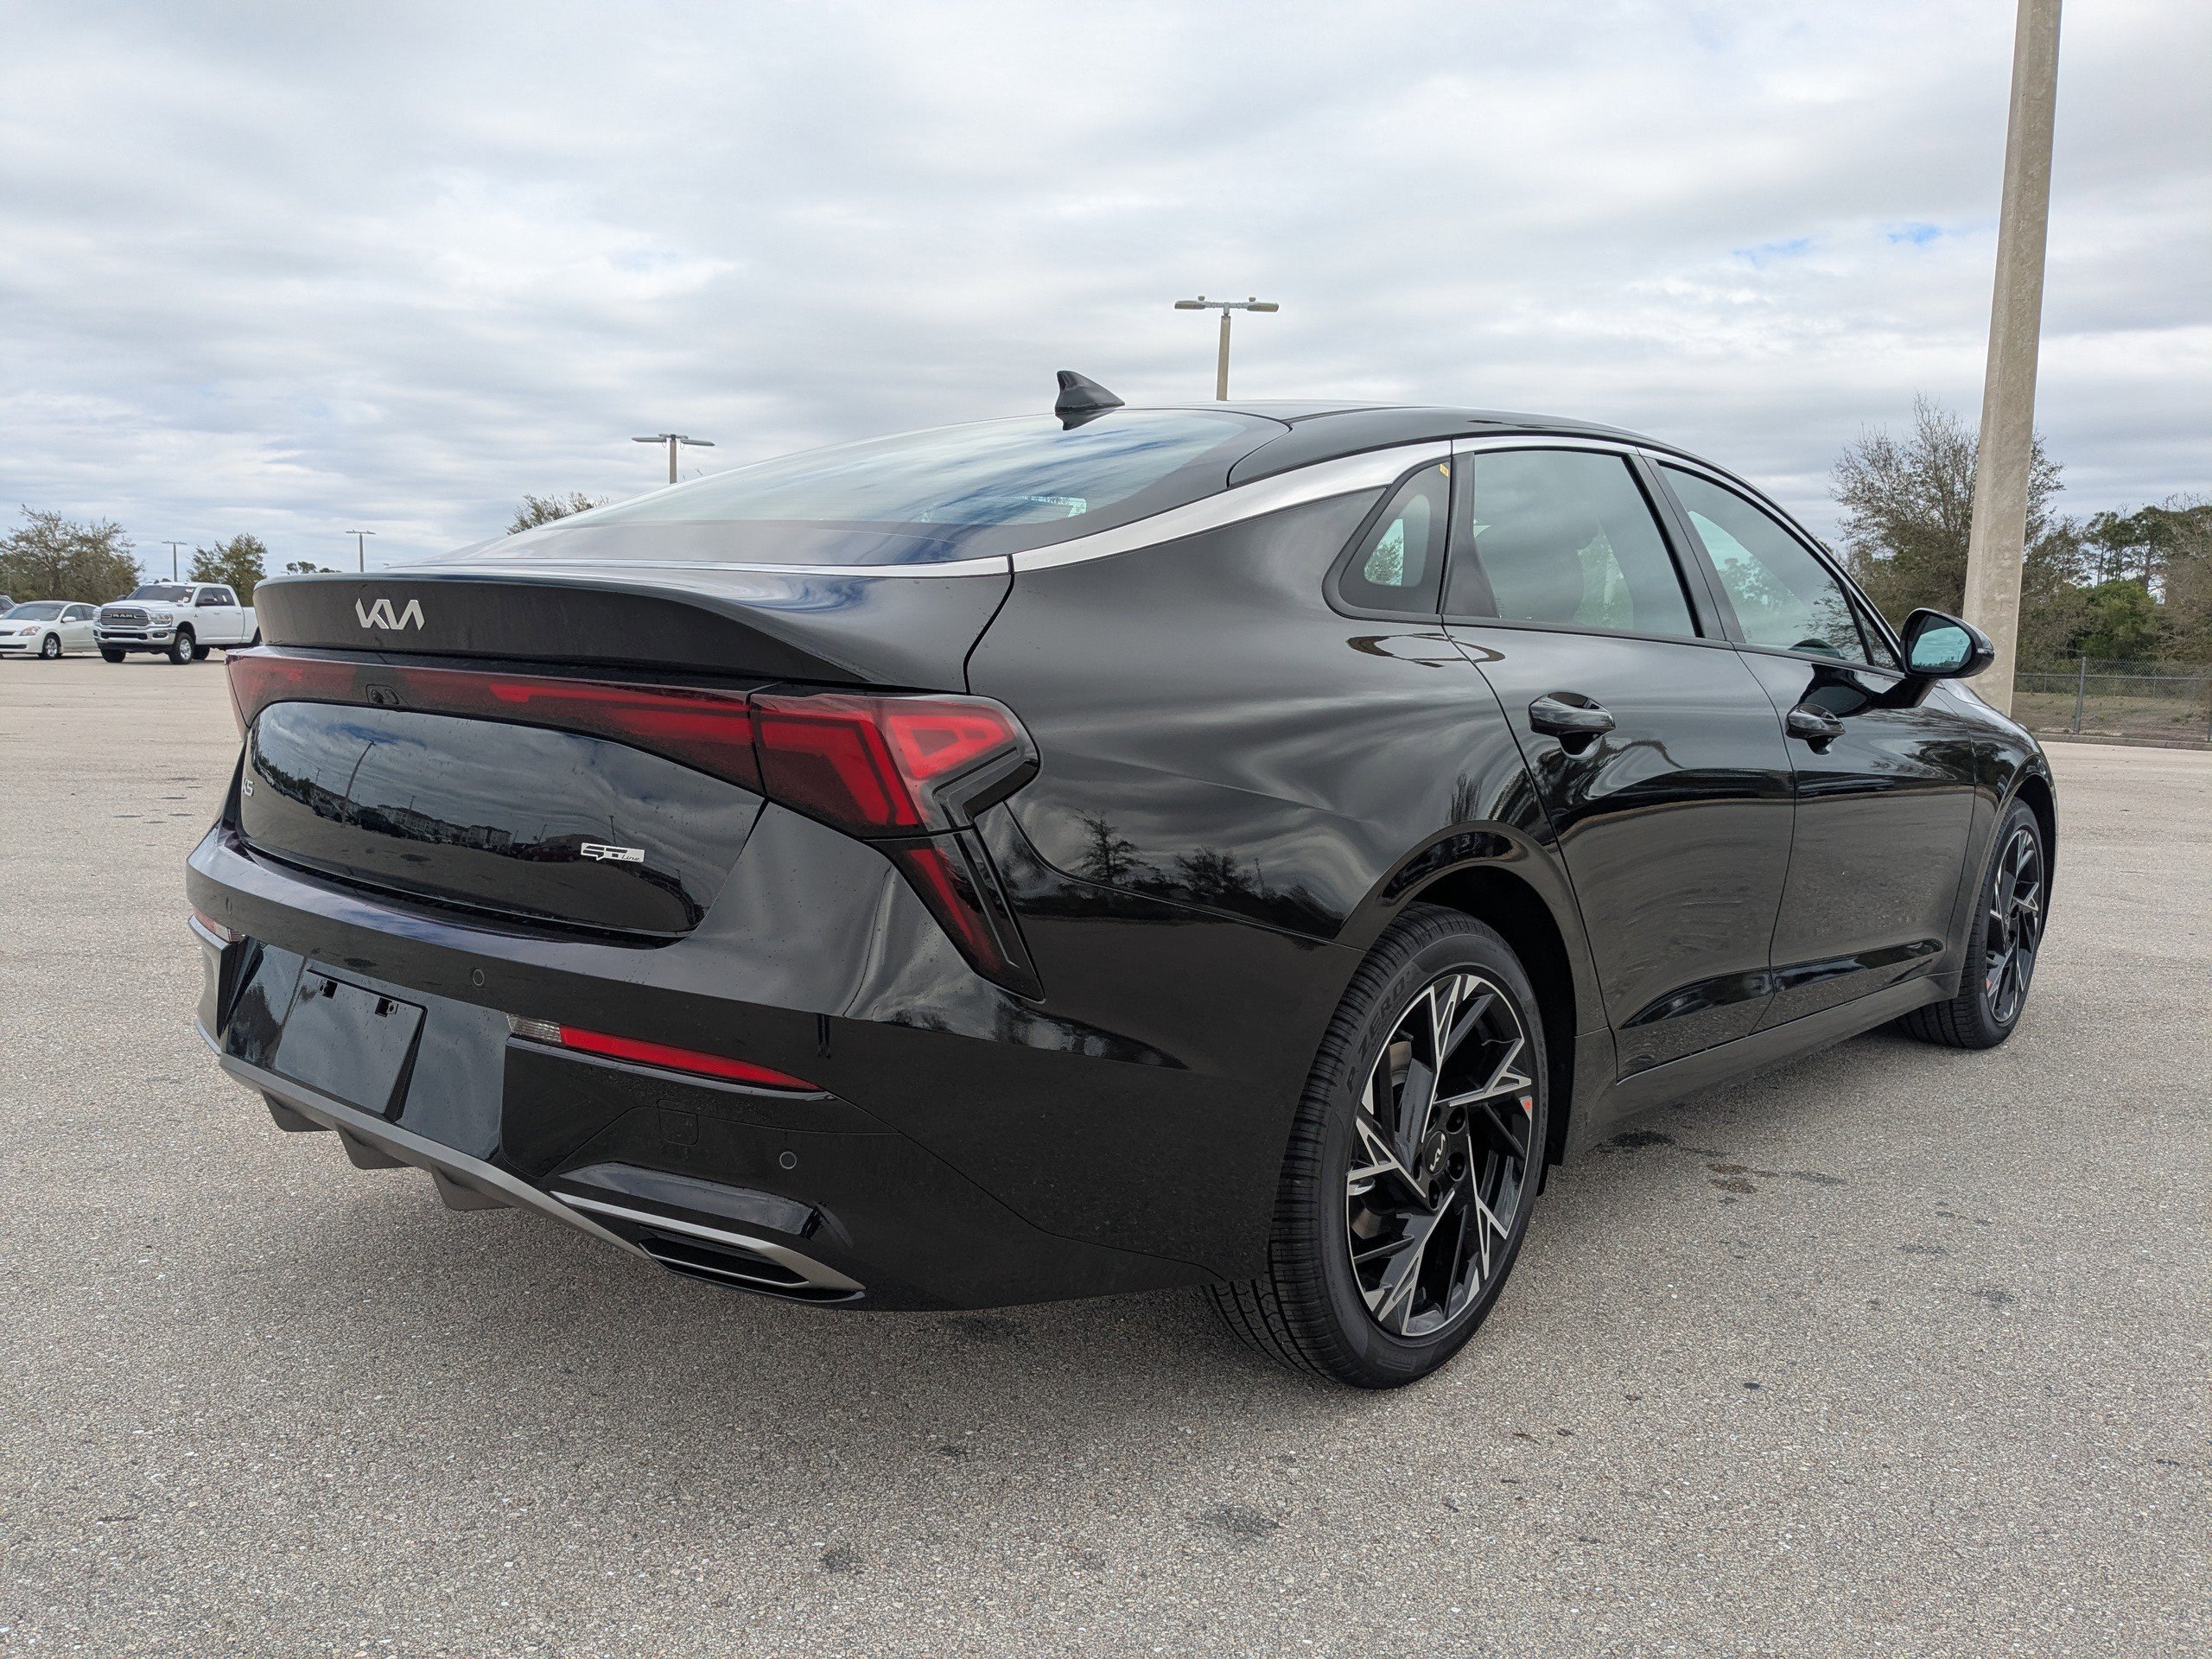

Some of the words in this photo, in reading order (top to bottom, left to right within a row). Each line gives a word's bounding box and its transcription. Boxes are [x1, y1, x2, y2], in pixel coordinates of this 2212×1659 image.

[355, 598, 425, 630] KIA
[1346, 1066, 1356, 1094] P
[1357, 976, 1405, 1064] ZERO
